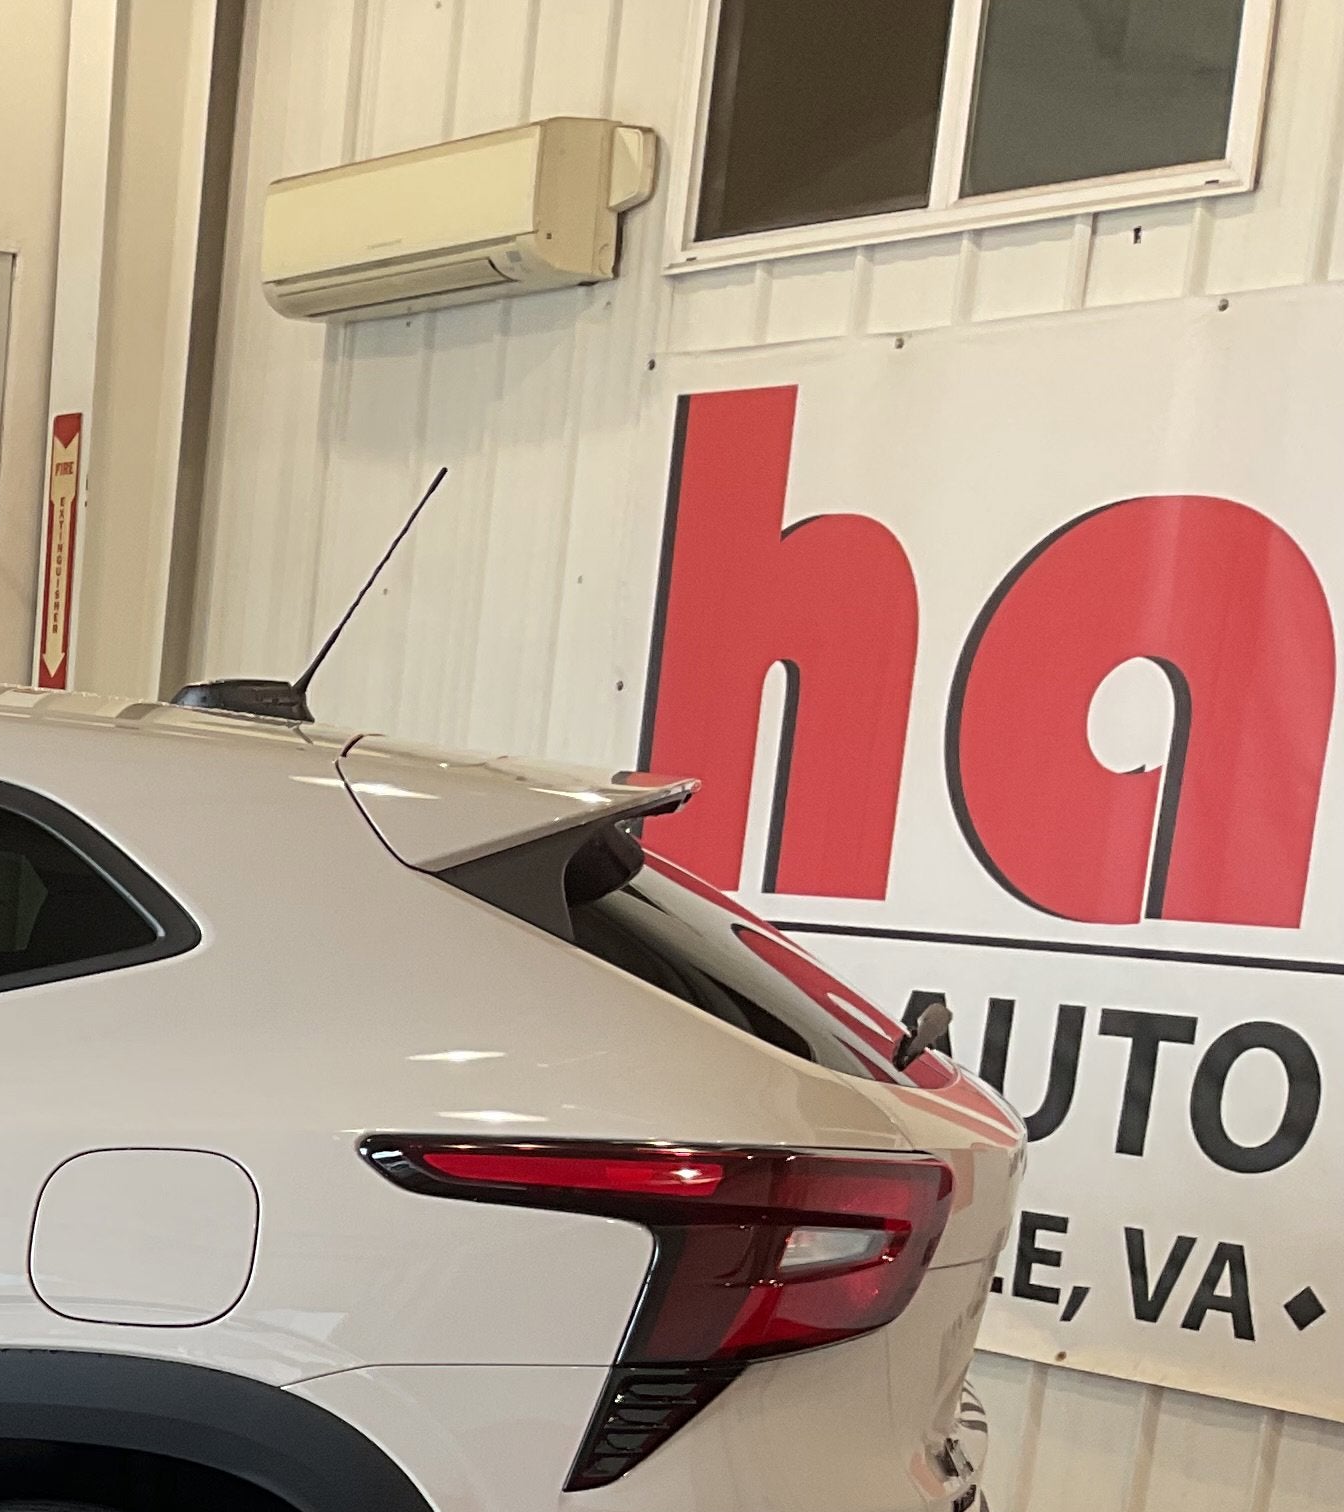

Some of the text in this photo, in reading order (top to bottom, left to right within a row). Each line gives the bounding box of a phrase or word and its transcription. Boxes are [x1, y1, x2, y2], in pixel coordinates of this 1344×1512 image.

[55, 461, 74, 476] FIRE
[52, 496, 65, 633] EXTINGUISHER
[1123, 1226, 1256, 1342] VA
